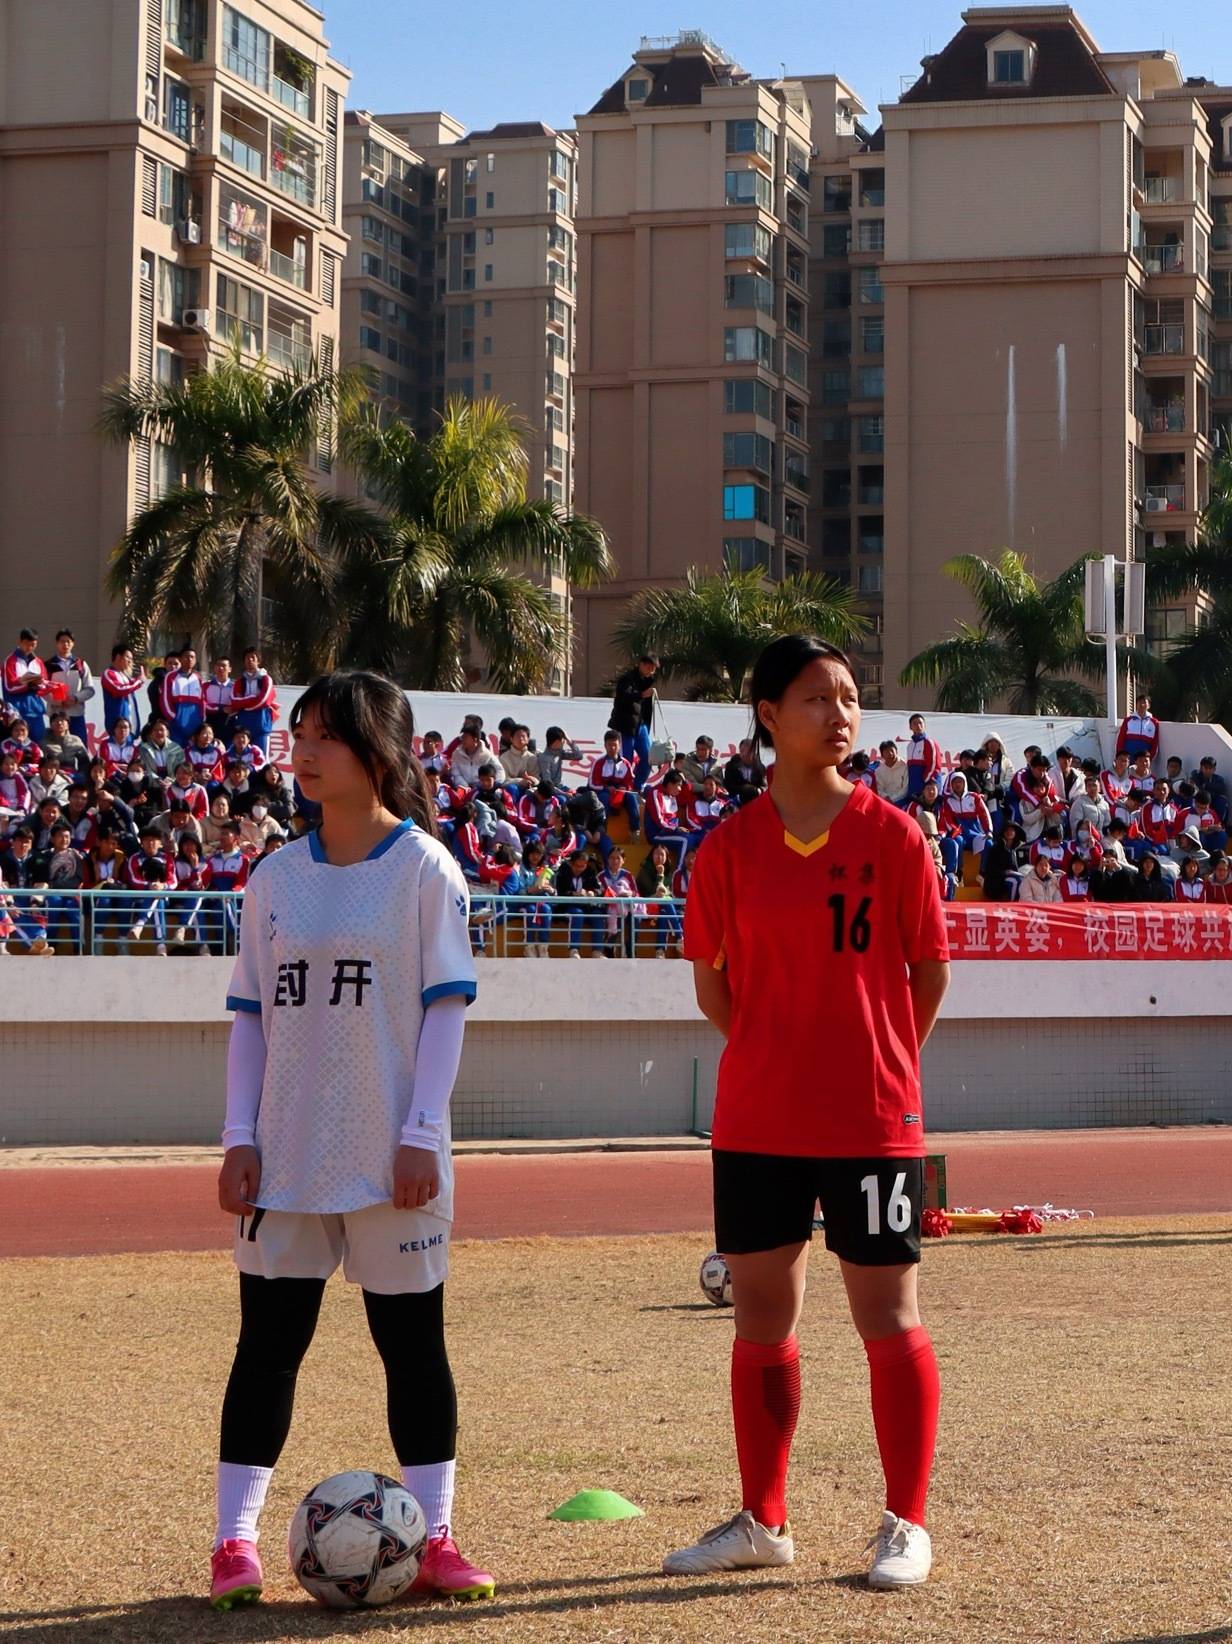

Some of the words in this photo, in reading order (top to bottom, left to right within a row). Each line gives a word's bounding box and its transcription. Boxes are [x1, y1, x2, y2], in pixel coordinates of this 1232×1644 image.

[828, 893, 873, 953] 16
[861, 1172, 911, 1235] 16
[400, 1234, 443, 1253] KELME
